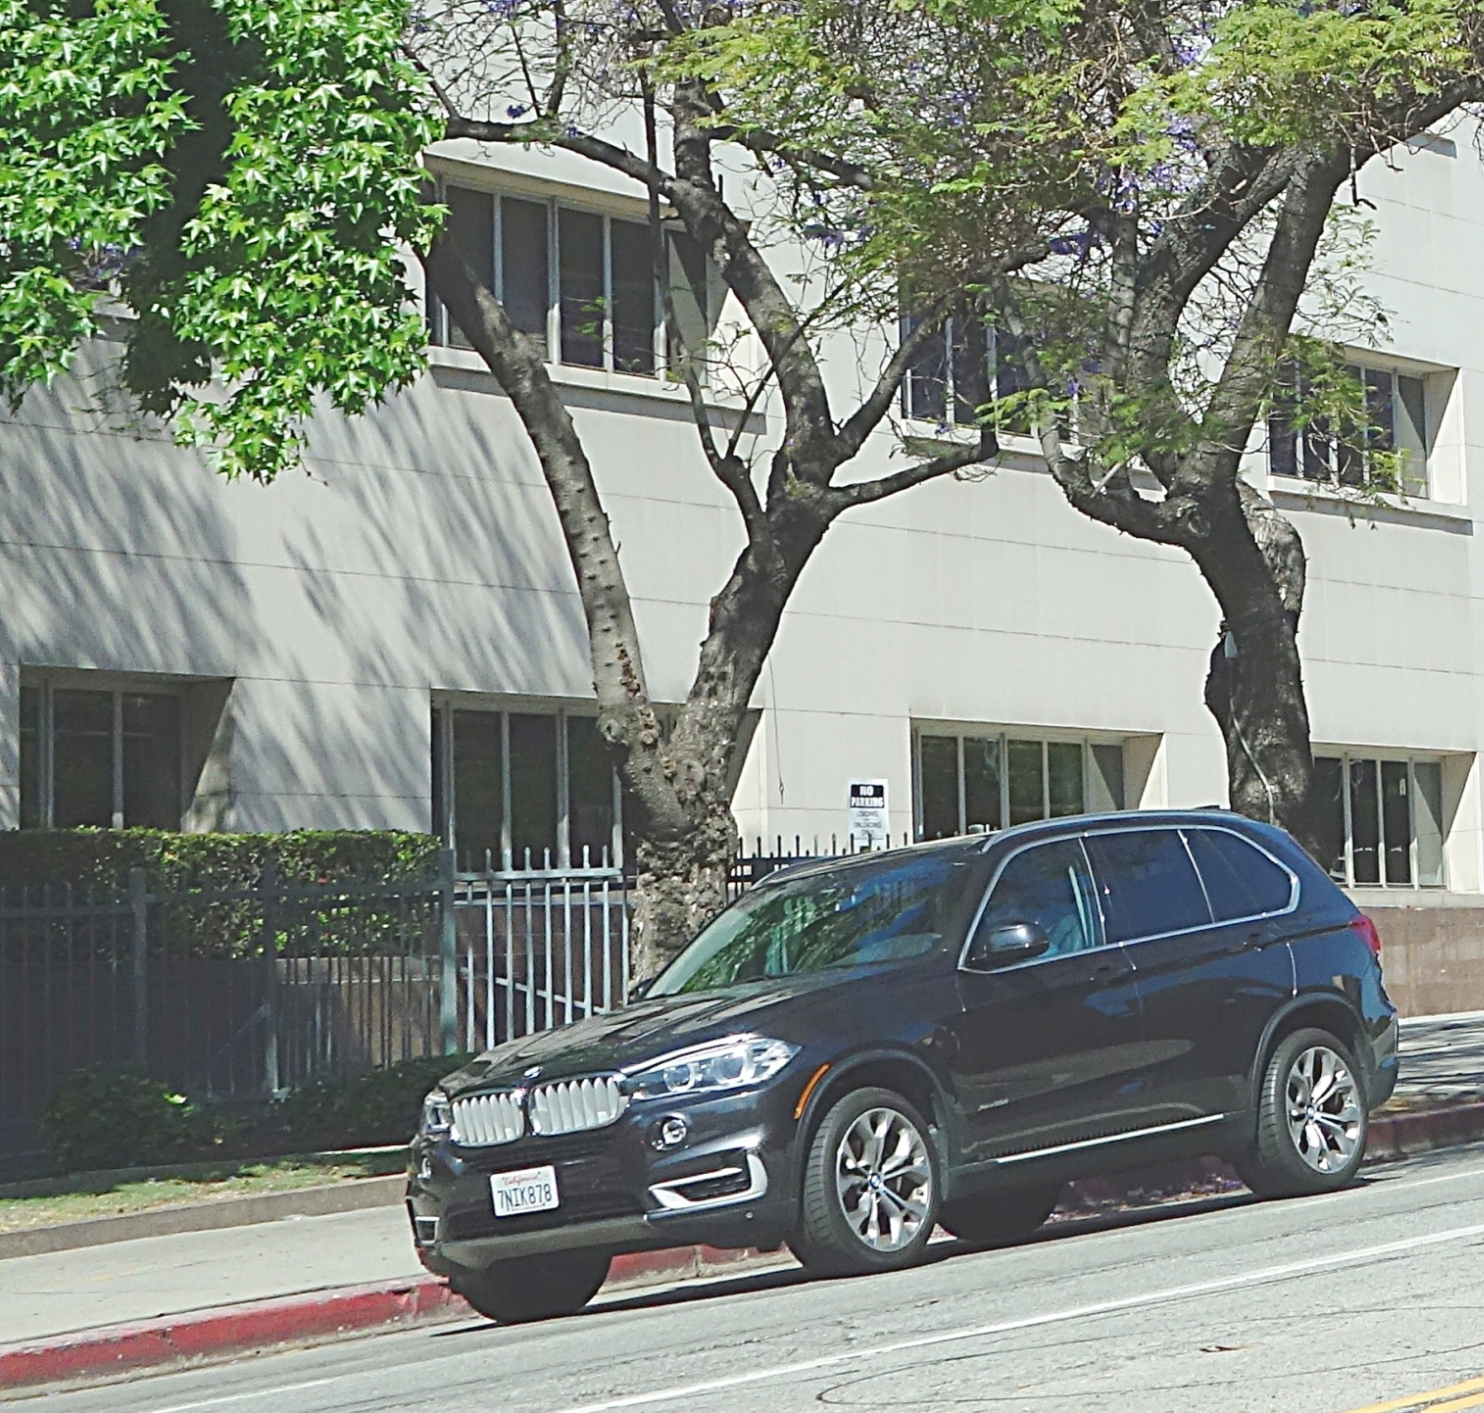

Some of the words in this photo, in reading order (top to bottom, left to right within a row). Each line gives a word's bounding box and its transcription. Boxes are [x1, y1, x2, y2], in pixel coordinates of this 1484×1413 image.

[859, 785, 874, 797] NO
[851, 796, 884, 808] PARKING
[497, 1183, 552, 1212] 7NIK878
